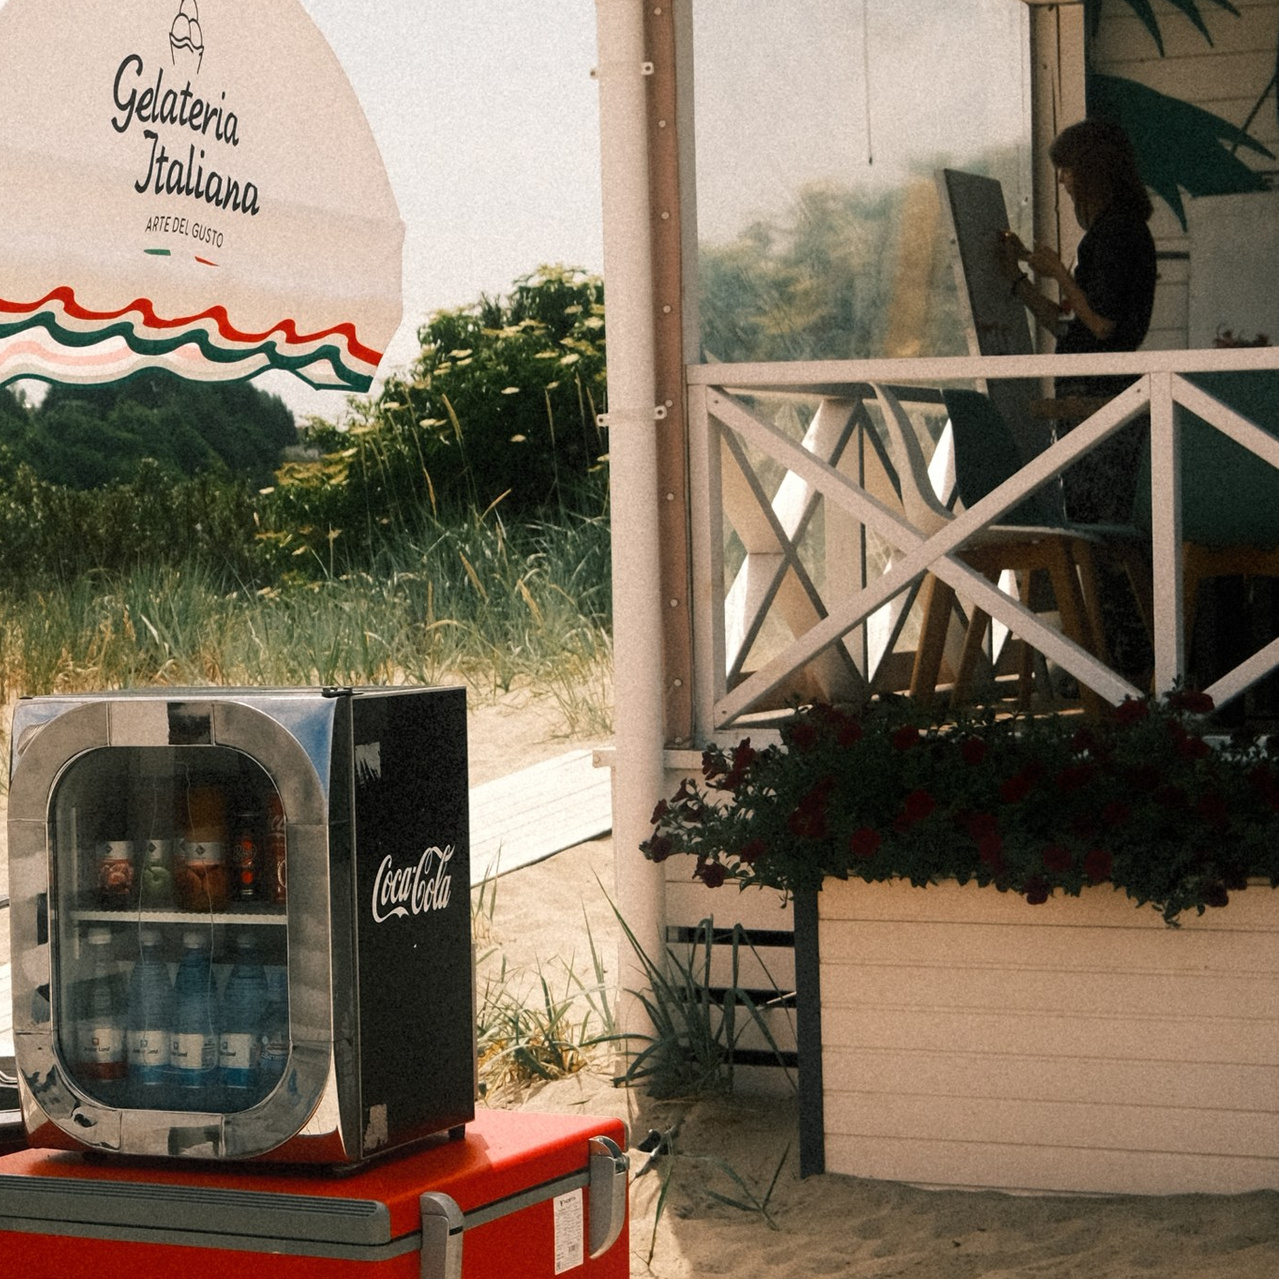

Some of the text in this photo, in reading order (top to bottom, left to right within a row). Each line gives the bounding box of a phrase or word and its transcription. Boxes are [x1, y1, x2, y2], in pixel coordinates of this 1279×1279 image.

[111, 53, 240, 147] Gelateria
[134, 129, 260, 216] Italiana
[144, 216, 224, 248] ARTE DEL GUSTO
[371, 844, 455, 924] Coca-Cola
